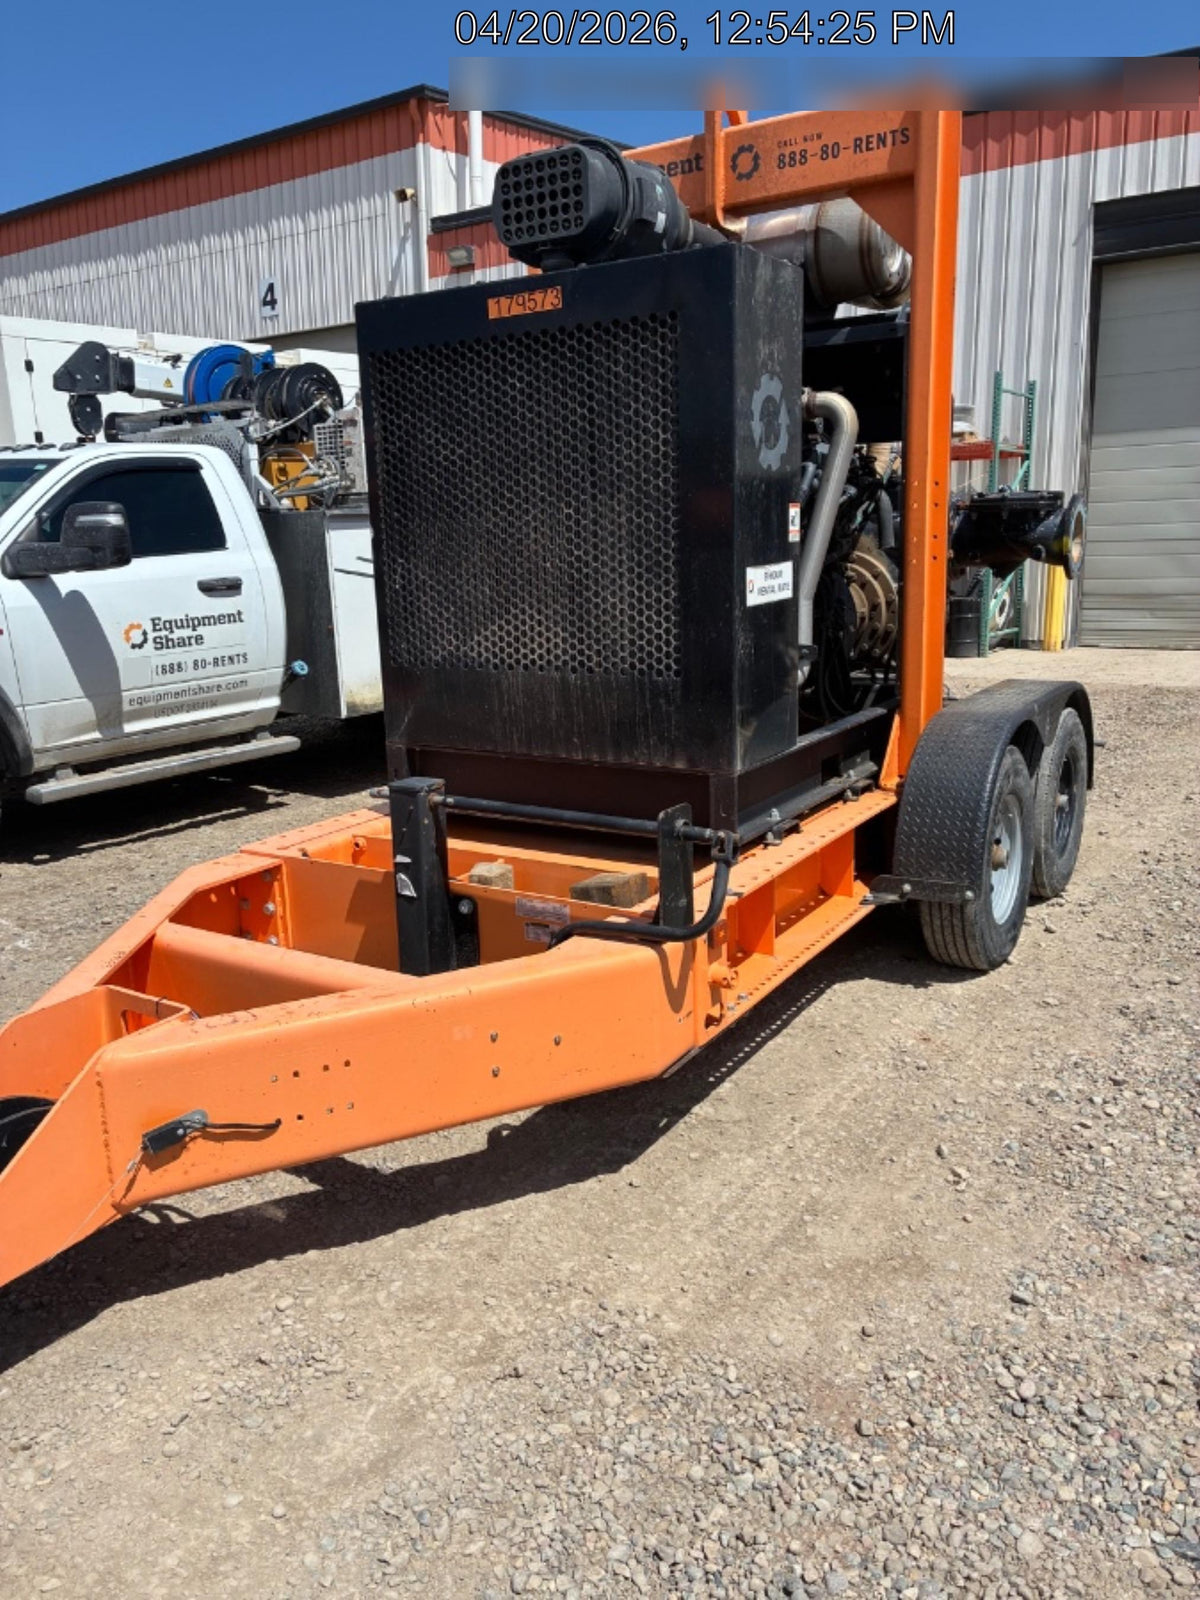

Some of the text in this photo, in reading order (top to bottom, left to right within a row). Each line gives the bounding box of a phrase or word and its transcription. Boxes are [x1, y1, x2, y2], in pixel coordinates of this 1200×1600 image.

[776, 128, 911, 170] 888-80-RENTS
[777, 132, 823, 148] CALL NOW
[660, 152, 704, 178] ent
[262, 282, 278, 311] 4
[494, 287, 561, 316] 179573
[150, 609, 244, 633] Equipment
[152, 633, 205, 651] Share
[155, 652, 248, 676] (888) 80-RENTS
[128, 679, 248, 706] equipmentshare.com
